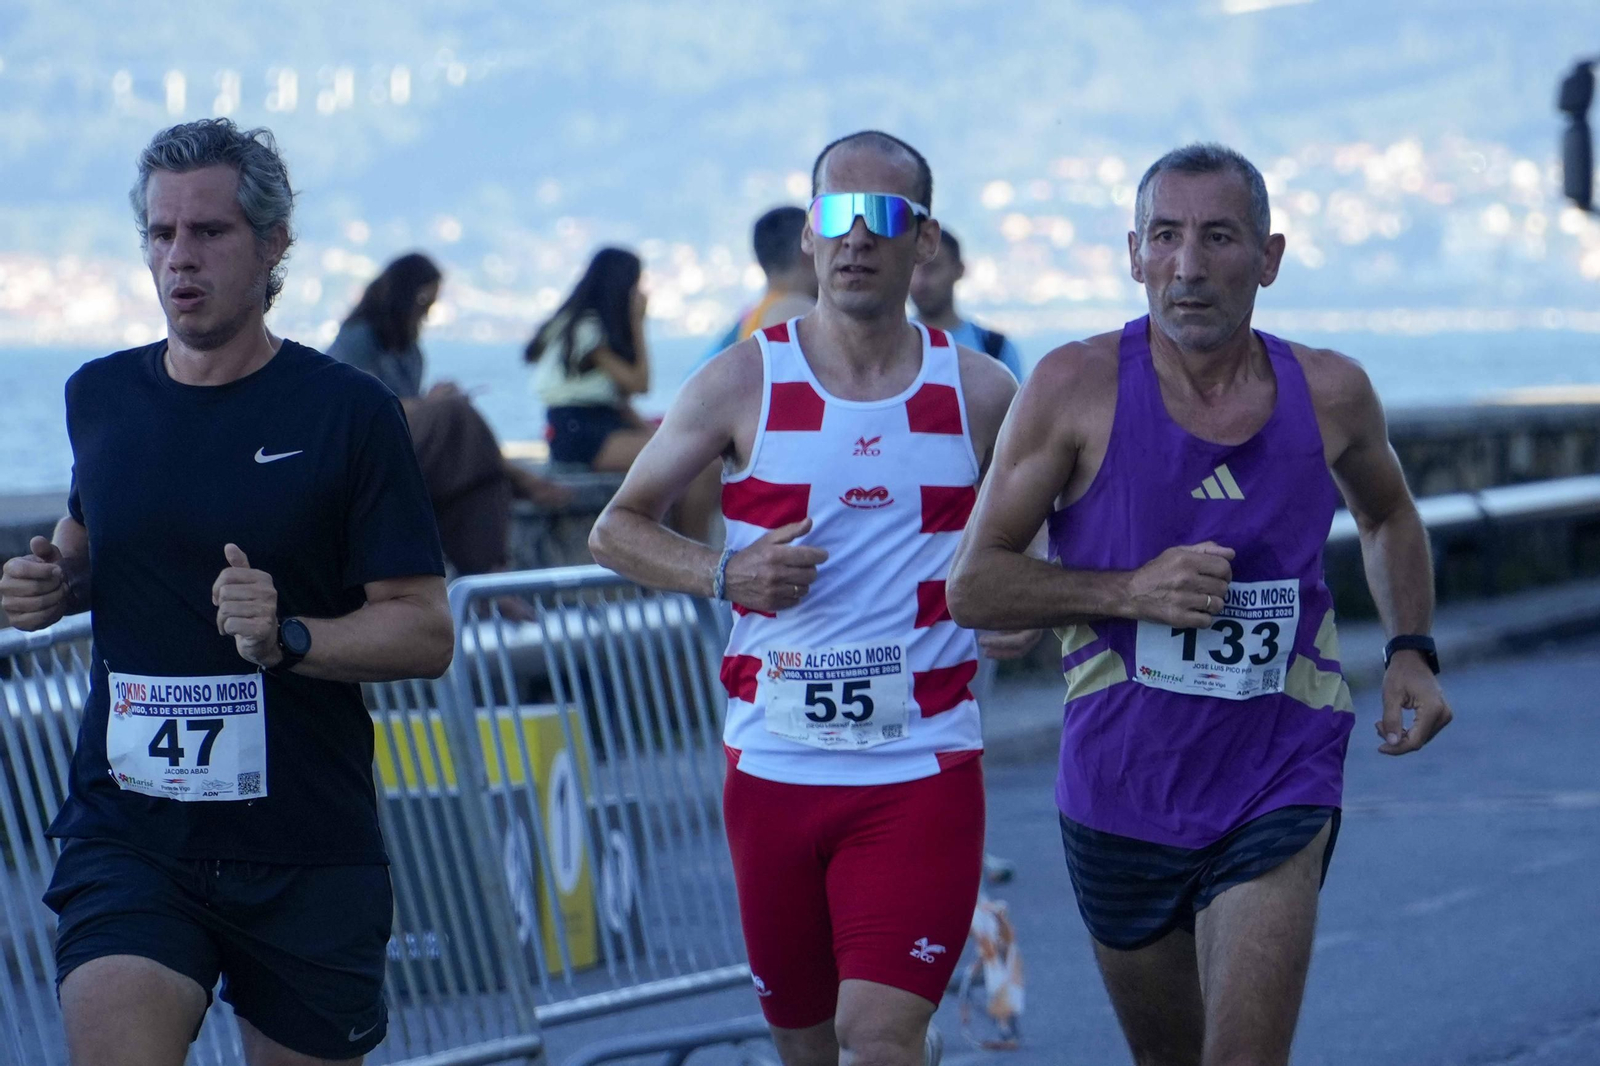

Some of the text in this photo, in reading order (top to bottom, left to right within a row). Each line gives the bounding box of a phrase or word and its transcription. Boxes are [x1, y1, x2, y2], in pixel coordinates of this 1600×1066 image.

[1223, 587, 1295, 607] ONSO MORO
[1275, 608, 1293, 617] 2026
[1171, 618, 1280, 666] 133
[767, 645, 901, 668] 10KMS ALFONSO MORO
[804, 672, 813, 680] 13
[826, 669, 869, 679] SETEMBRO
[869, 667, 880, 675] DE
[881, 664, 900, 673] 2026
[1210, 664, 1224, 672] LUIS
[1225, 666, 1241, 674] PICO
[115, 681, 258, 702] 10KMS ALFONSO MORO
[805, 680, 874, 723] 55
[131, 703, 256, 715] VIGO, 13 DE SETEMBRO DE 2026
[149, 718, 224, 767] 47
